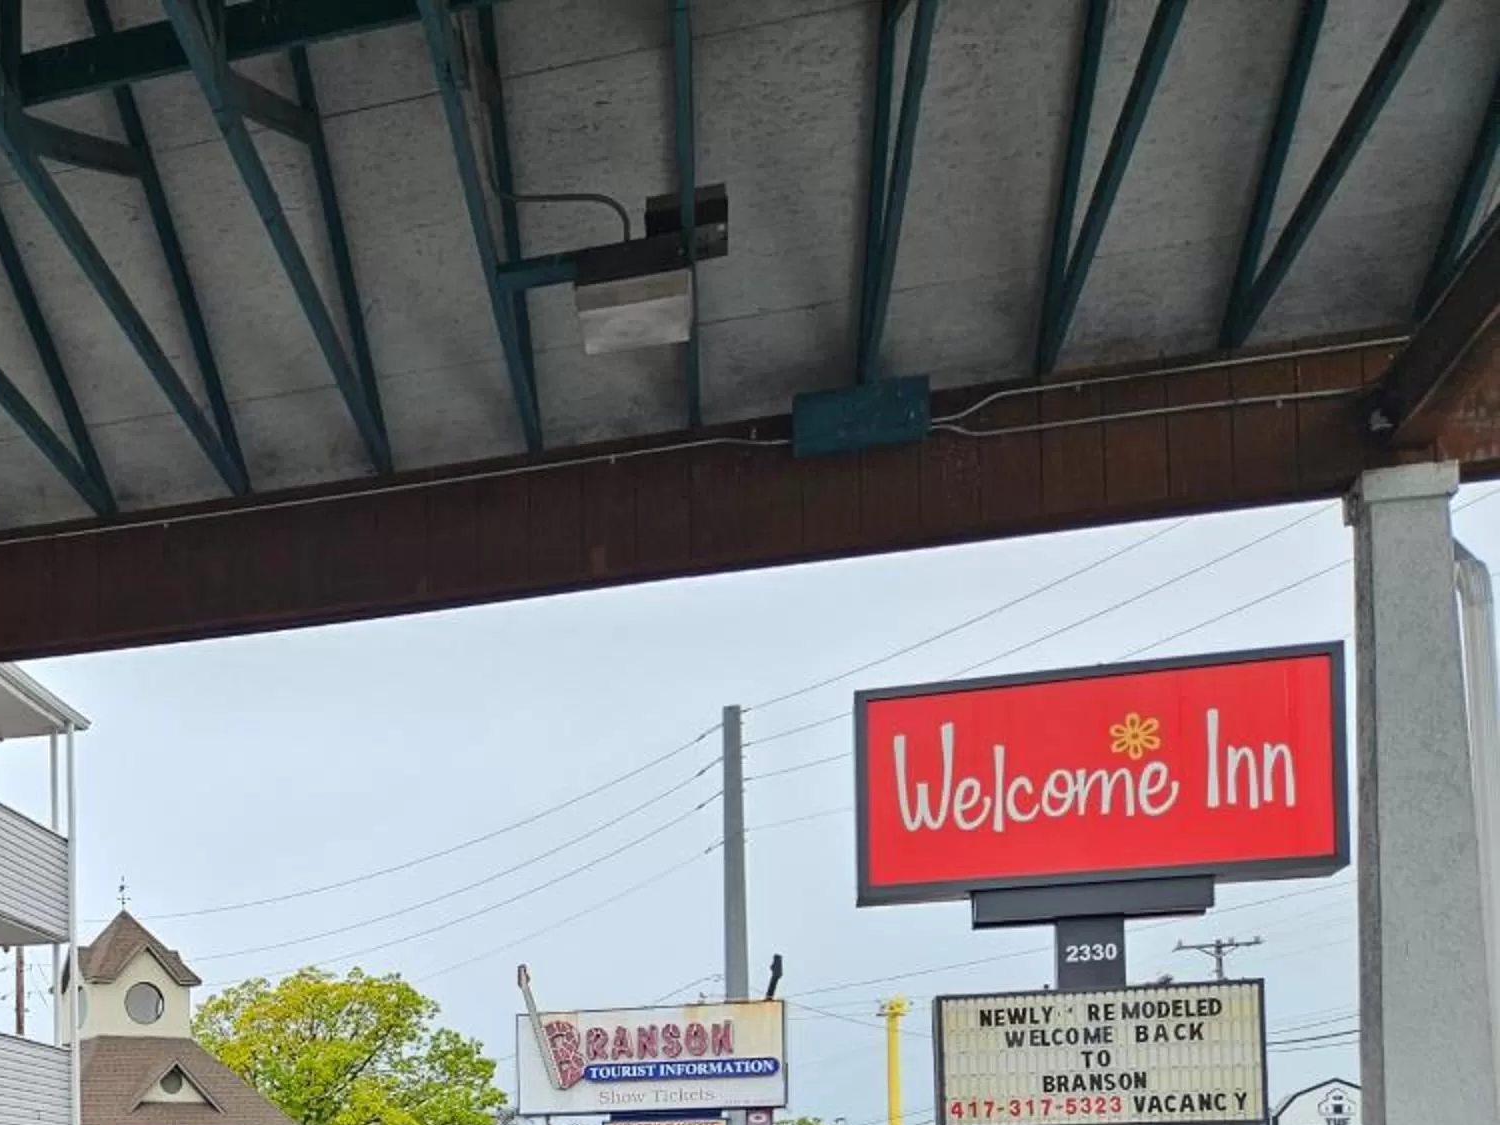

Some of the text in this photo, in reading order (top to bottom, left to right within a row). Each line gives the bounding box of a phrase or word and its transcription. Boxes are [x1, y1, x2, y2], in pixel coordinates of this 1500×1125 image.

[893, 708, 1296, 832] Welcome Inn
[1065, 943, 1118, 963] 2330
[979, 1005, 1053, 1027] NEWLY
[1005, 1022, 1205, 1048] WELCOME BACK
[544, 1020, 735, 1090] BRANSON
[1081, 1050, 1111, 1069] TO
[589, 1059, 775, 1079] TOURIST INFORMATION
[1043, 1072, 1148, 1093] BRANSON
[599, 1086, 716, 1105] Show Tickets
[950, 1092, 1248, 1119] 417-317-5323 VACANCY
